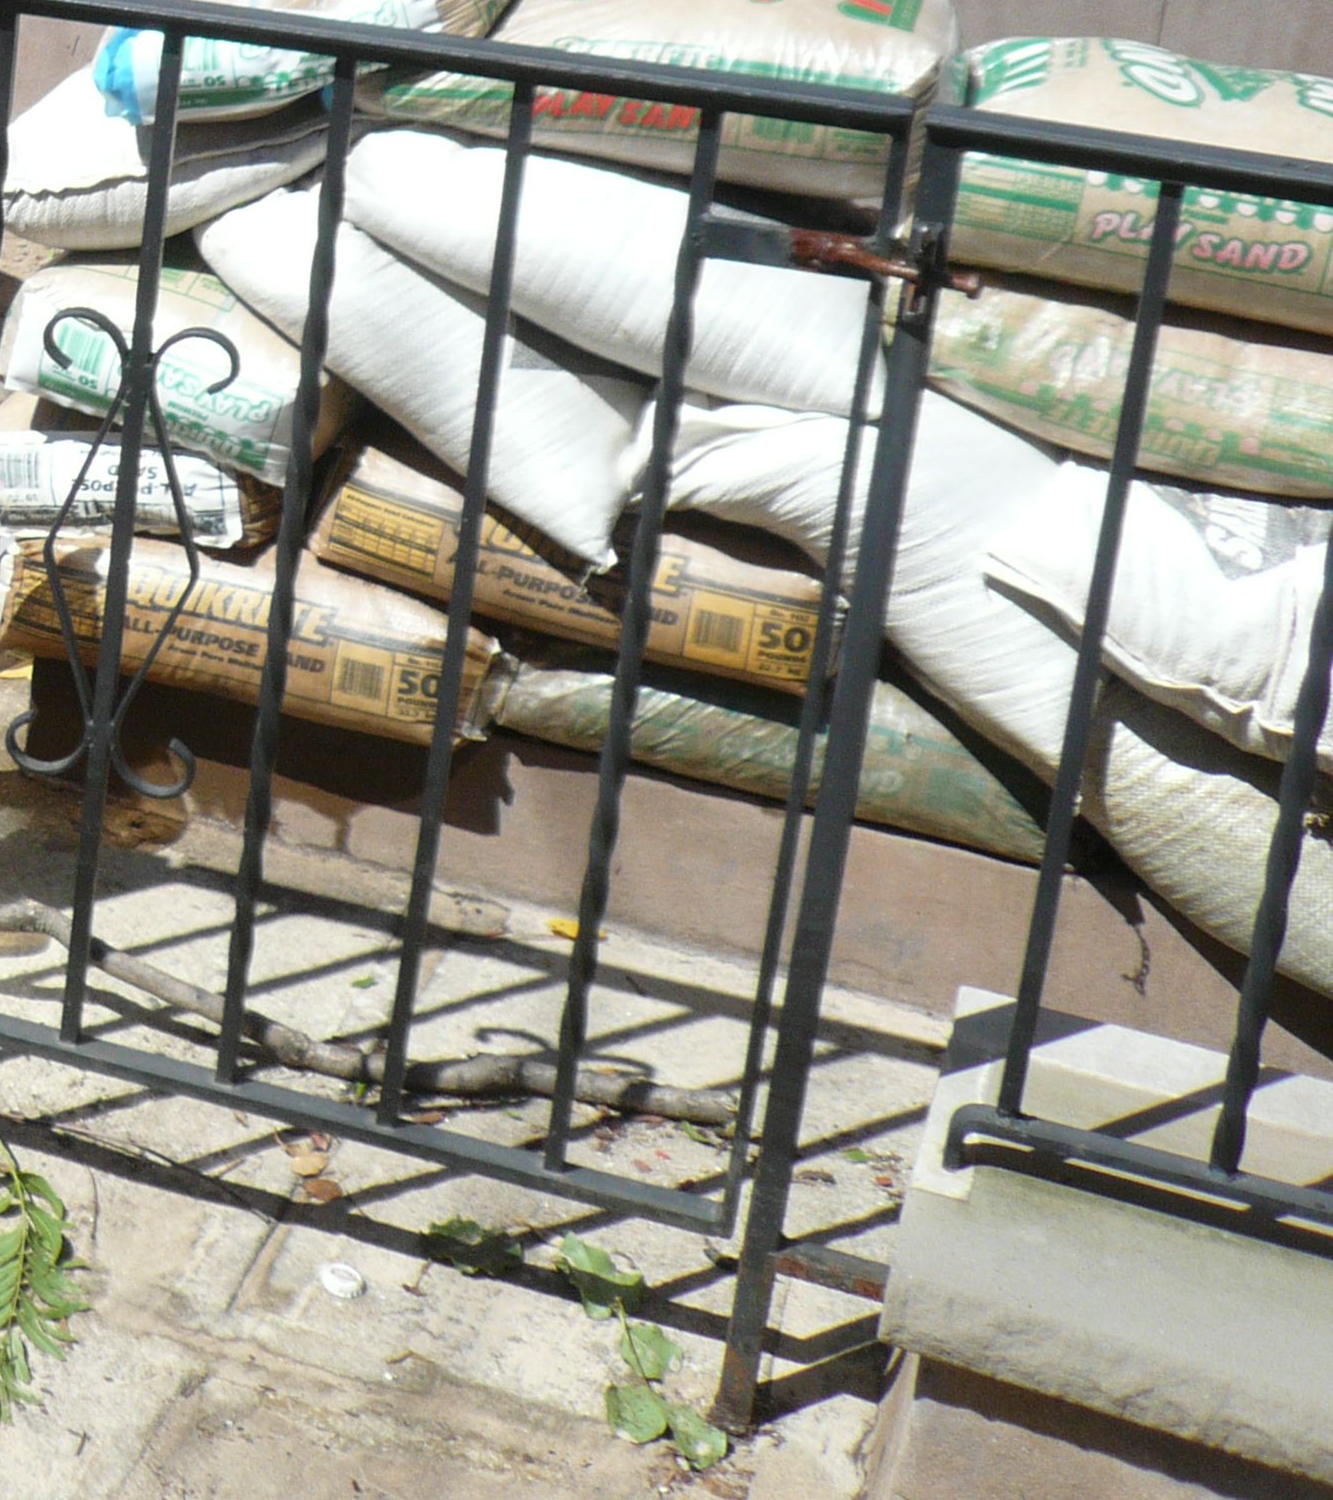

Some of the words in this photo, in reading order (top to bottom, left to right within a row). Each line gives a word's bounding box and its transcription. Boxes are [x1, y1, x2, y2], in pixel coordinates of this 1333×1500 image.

[619, 100, 701, 130] SAN
[1191, 231, 1311, 271] SAND
[154, 361, 201, 395] SA
[758, 621, 812, 653] 50
[397, 669, 440, 699] 50
